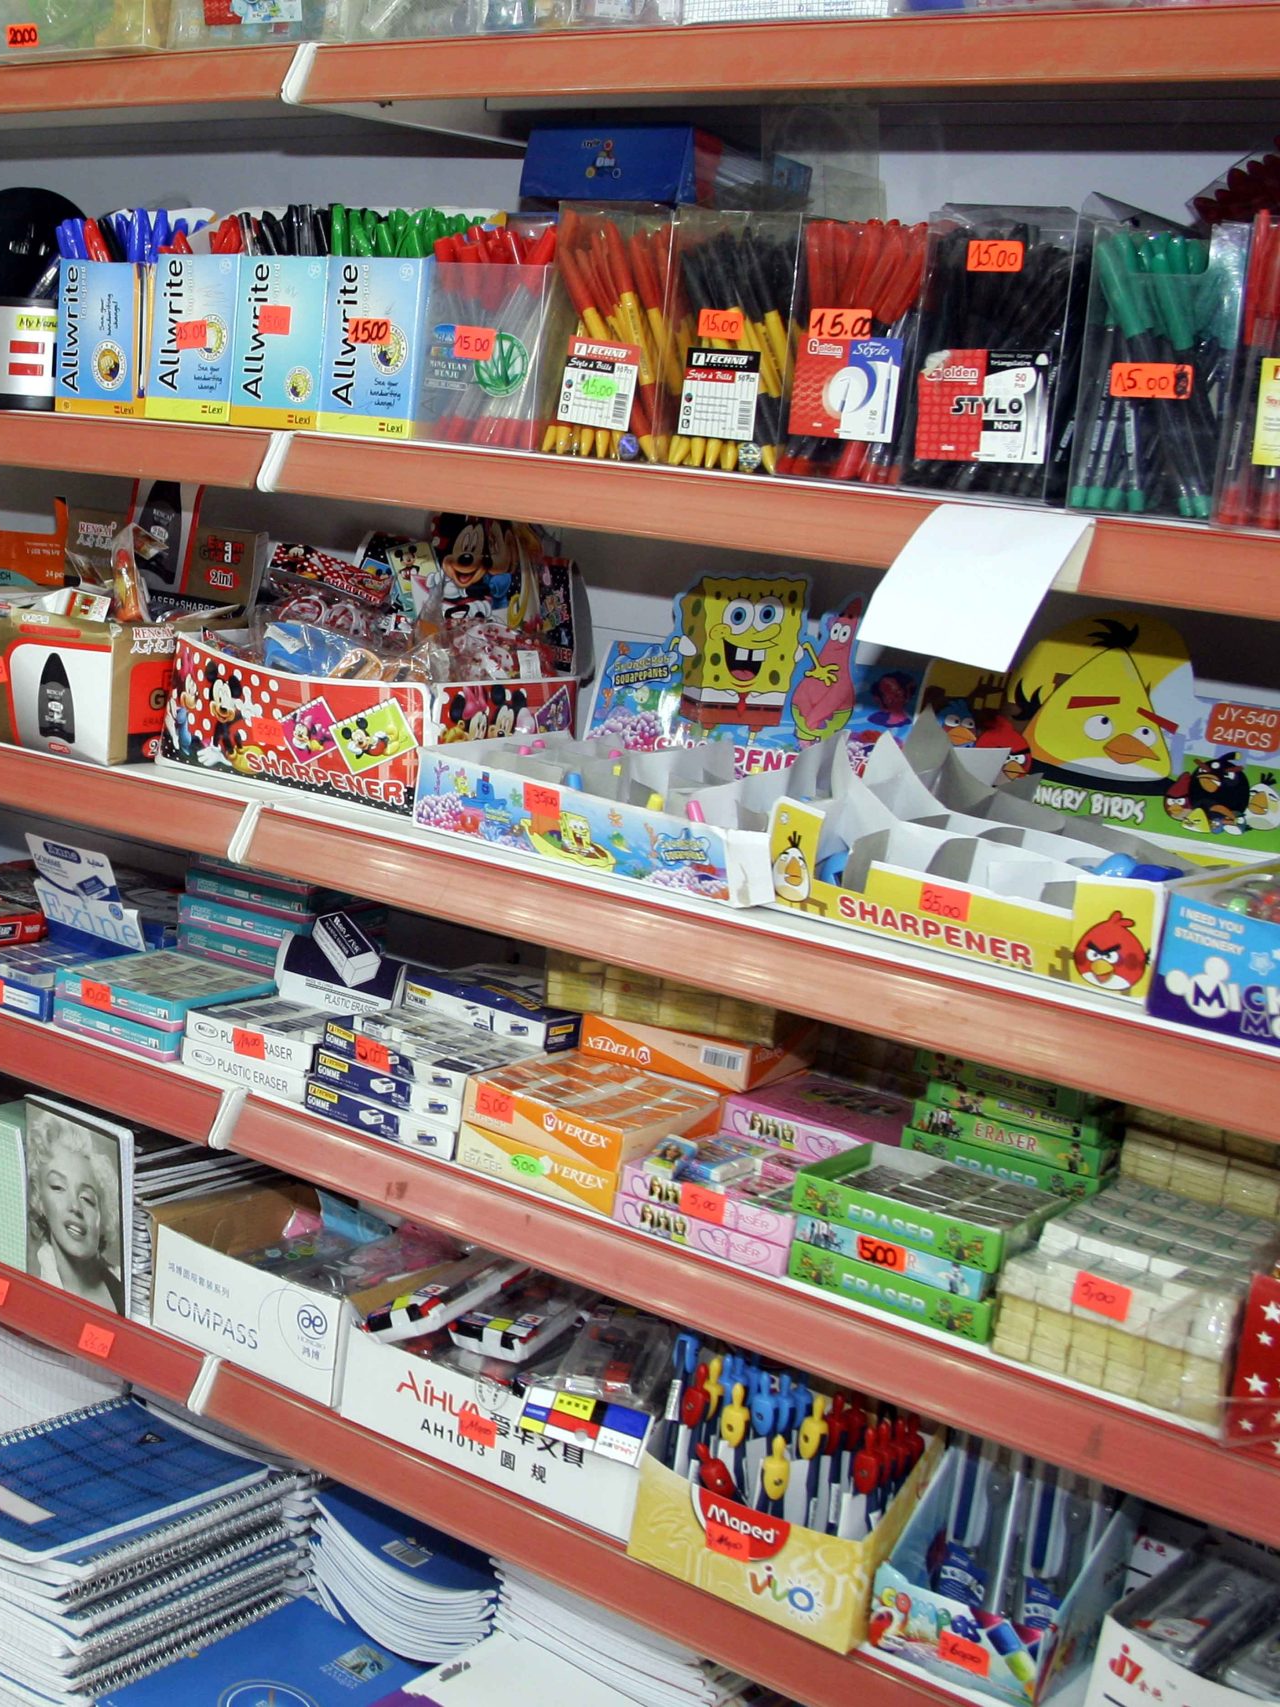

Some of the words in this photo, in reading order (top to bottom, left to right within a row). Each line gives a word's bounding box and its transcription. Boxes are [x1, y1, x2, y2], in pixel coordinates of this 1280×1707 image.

[971, 243, 1018, 268] 15.00
[62, 265, 80, 393] Allwrite
[586, 344, 628, 359] TECHNO
[808, 338, 843, 355] Golden
[852, 343, 890, 358] Stylo
[704, 353, 749, 365] TECHNO
[1015, 373, 1027, 383] 50
[208, 406, 223, 415] Lexi
[950, 396, 1024, 415] STYLO
[294, 415, 311, 425] Lexi
[386, 422, 403, 433] Lexi
[993, 420, 1019, 432] Noir
[1217, 706, 1278, 728] JY-540
[1212, 726, 1272, 749] 24PCS
[246, 752, 404, 806] SHARPENER
[1032, 784, 1088, 812] ANGRY
[1090, 792, 1146, 825] BIRDS
[839, 895, 1033, 967] SHARPENER
[265, 1042, 294, 1062] RASER
[325, 1032, 348, 1050] GOMME
[586, 1035, 636, 1057] VERTEX
[216, 1056, 251, 1082] PLASTIC
[252, 1071, 289, 1094] ERASER
[317, 1065, 341, 1081] GOMME
[307, 1094, 330, 1111] GOMME
[556, 1118, 612, 1150] VERTEX
[974, 1120, 1038, 1153] ERASER
[552, 1159, 609, 1190] VERTEX
[847, 1202, 935, 1246] ERASER
[840, 1272, 927, 1317] ERASER
[165, 1290, 259, 1351] COMPASS
[420, 1418, 486, 1458] AH1013
[500, 1450, 516, 1472] 圆
[531, 1463, 548, 1485] 规
[707, 1502, 776, 1545] Maped
